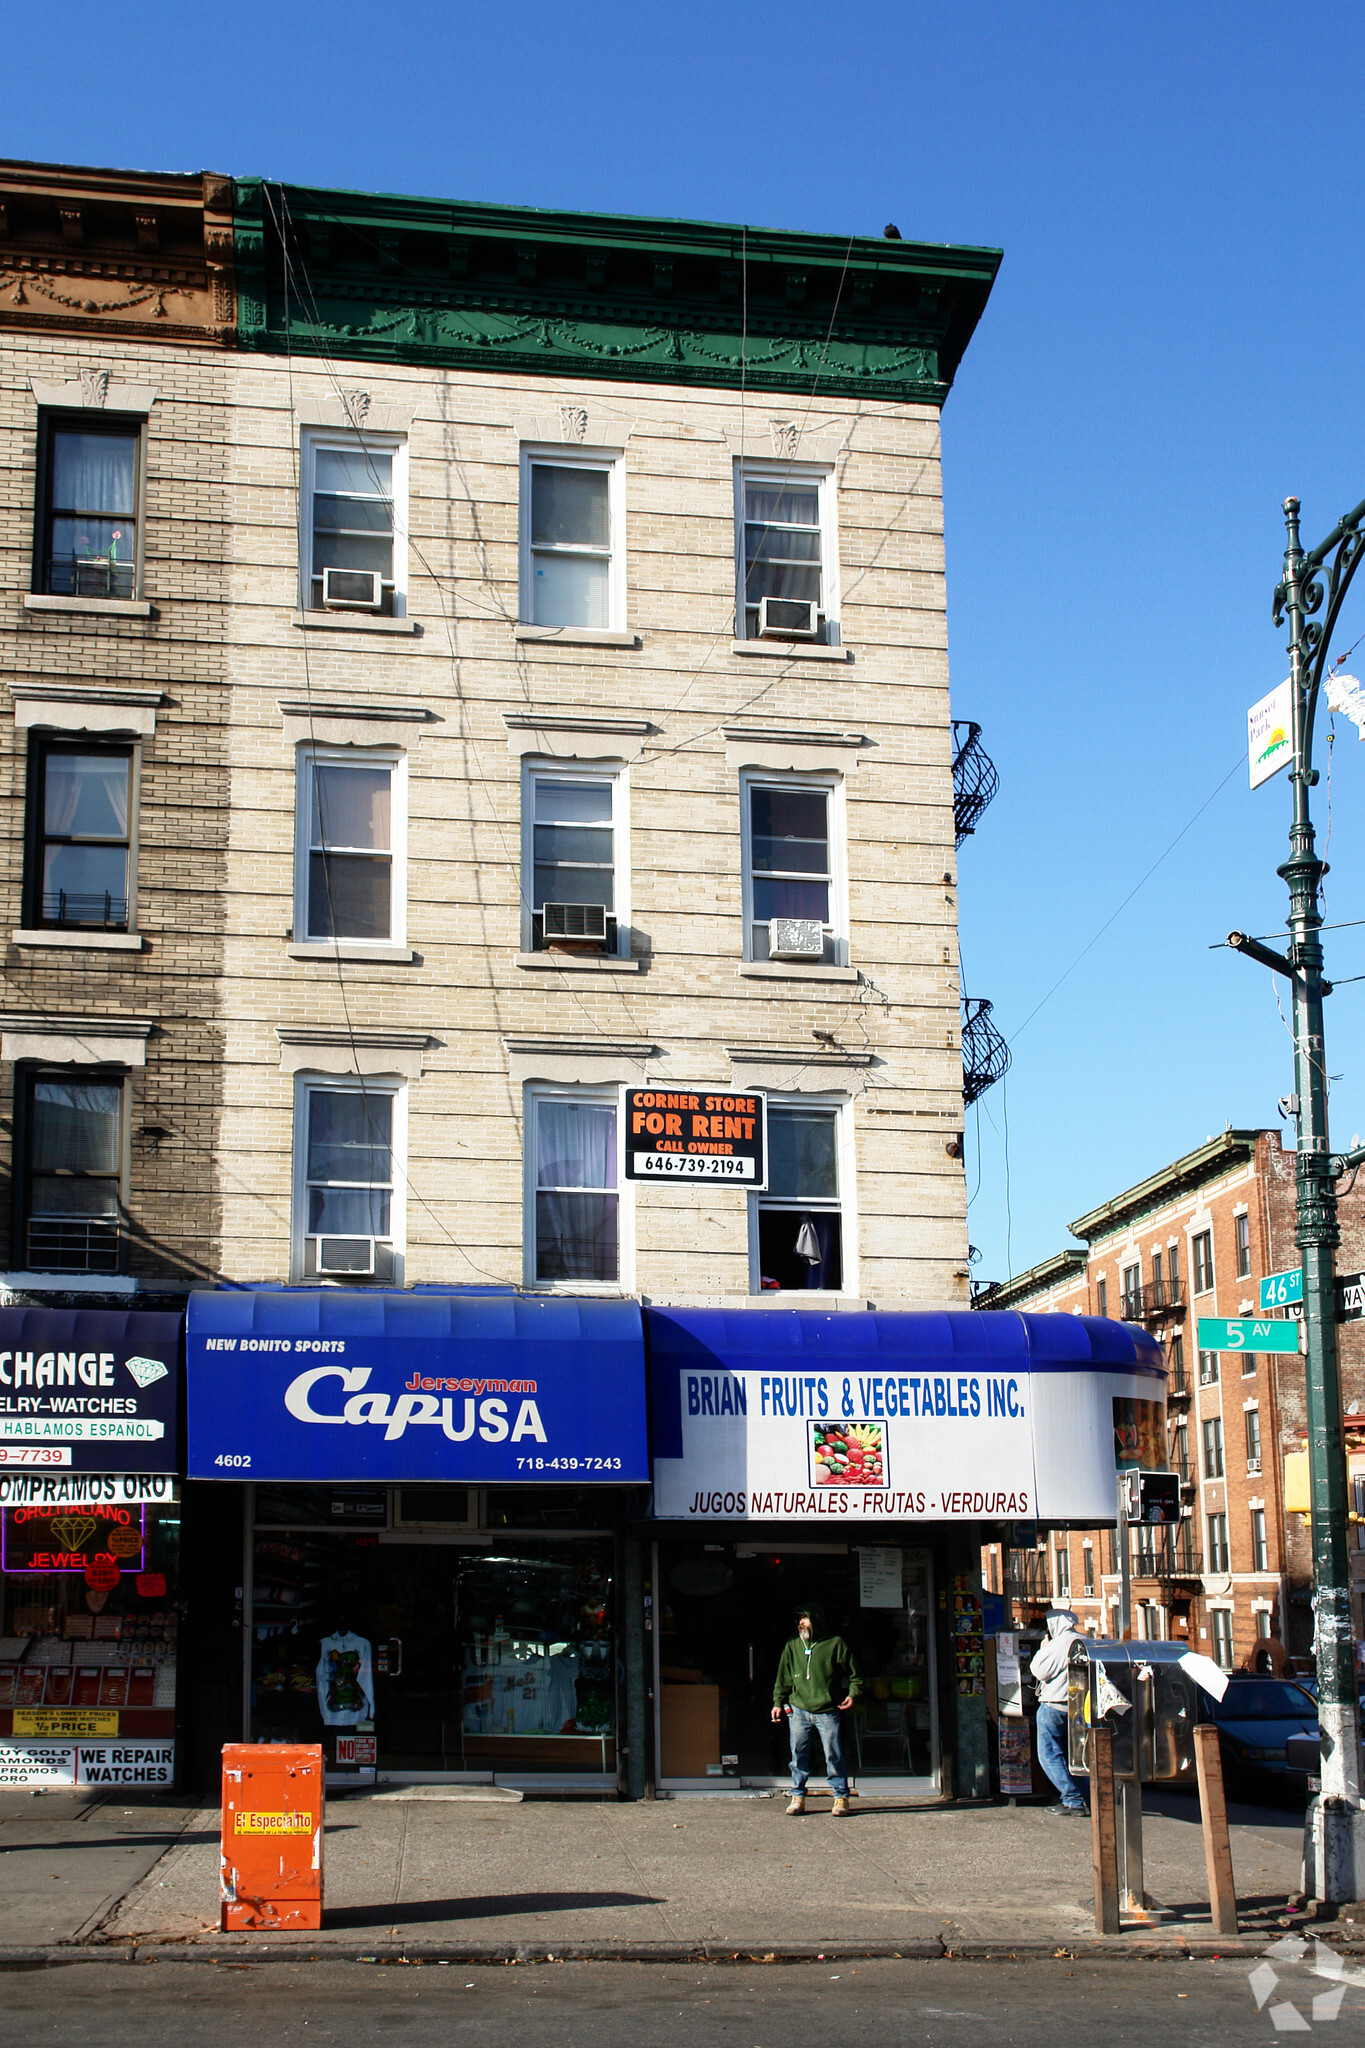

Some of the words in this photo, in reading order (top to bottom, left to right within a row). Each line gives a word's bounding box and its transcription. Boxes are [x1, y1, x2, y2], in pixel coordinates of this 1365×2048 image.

[632, 1093, 700, 1110] CORNER
[705, 1096, 756, 1113] STORE
[632, 1112, 682, 1136] FOR
[692, 1114, 756, 1140] RENT
[655, 1140, 684, 1153] CALL
[687, 1142, 734, 1155] OWNER
[645, 1157, 744, 1174] 646-739-2194
[1266, 1277, 1287, 1304] 46
[1289, 1273, 1301, 1288] ST
[1226, 1322, 1245, 1348] 5
[1252, 1323, 1272, 1337] AV
[205, 1339, 237, 1351] NEW
[239, 1339, 291, 1352] BONITO
[294, 1340, 346, 1353] SPORTS
[0, 1352, 115, 1389] CHANGE
[405, 1372, 537, 1396] Jerseyman
[688, 1376, 747, 1416] BRIAN
[760, 1377, 829, 1417] FRUITS
[841, 1377, 855, 1417] &
[858, 1377, 981, 1418] VEGETABLES
[986, 1378, 1025, 1418] INC.
[4, 1422, 83, 1436] HABLAMOS
[90, 1421, 153, 1437] ESPAÑOL
[214, 1455, 252, 1468] 4602
[516, 1458, 622, 1470] 718-439-7243
[123, 1475, 166, 1500] ORO
[689, 1492, 746, 1514] JUGOS
[751, 1492, 848, 1514] NATURALES
[863, 1492, 926, 1514] FRUTAS
[940, 1492, 1028, 1514] VERDURAS
[522, 1687, 536, 1700] 21
[51, 1722, 97, 1731] PRICE
[80, 1749, 106, 1764] WE
[112, 1749, 173, 1764] REPAIR
[339, 1740, 354, 1760] NO
[86, 1767, 168, 1782] WATCHES
[236, 1813, 246, 1827] El
